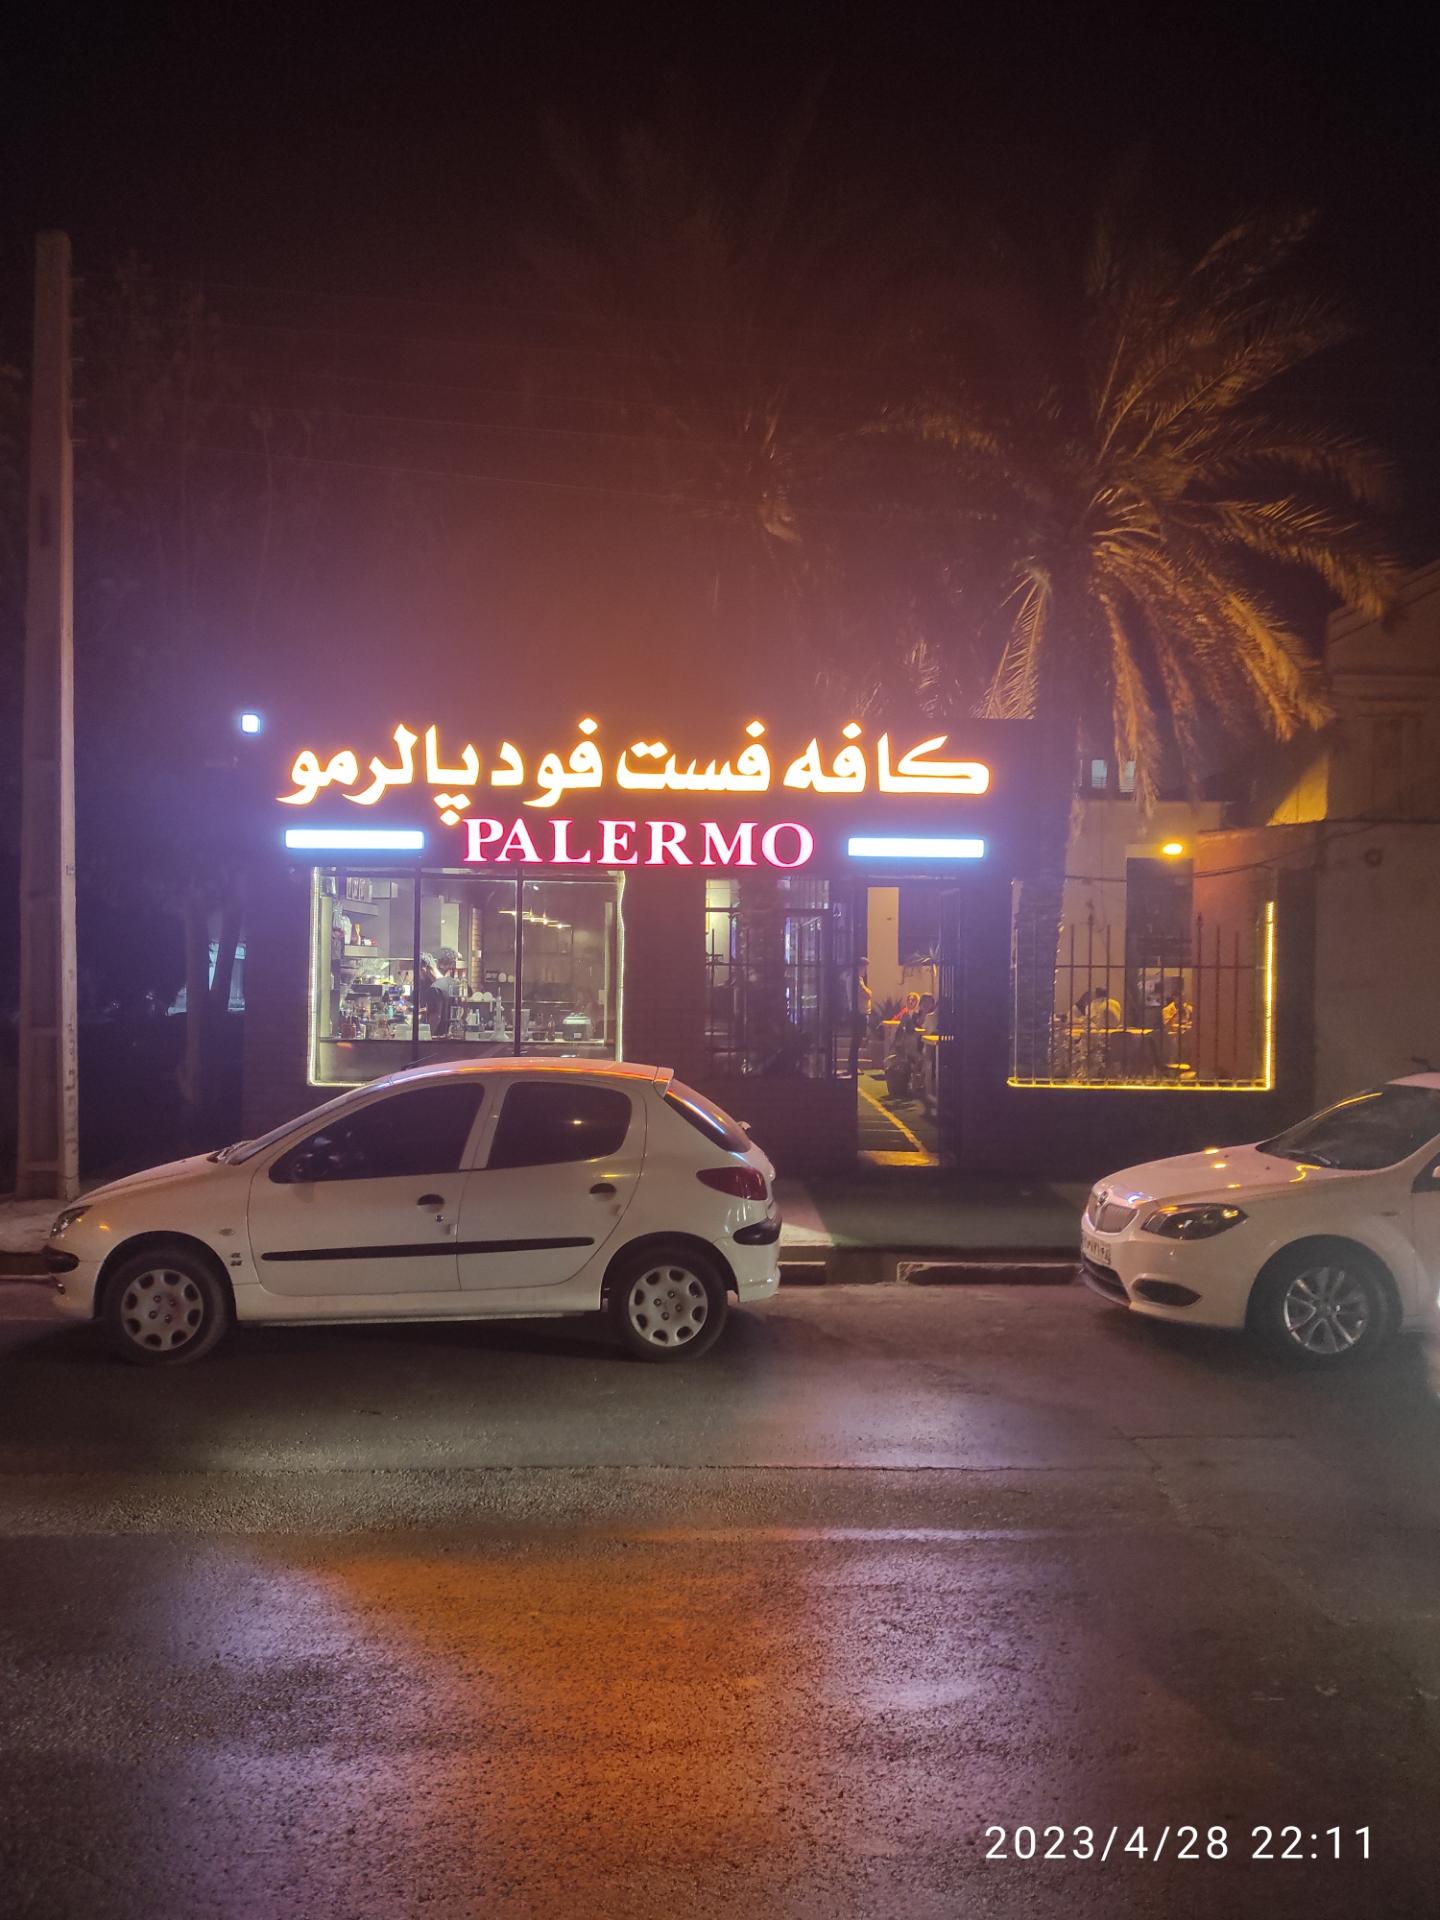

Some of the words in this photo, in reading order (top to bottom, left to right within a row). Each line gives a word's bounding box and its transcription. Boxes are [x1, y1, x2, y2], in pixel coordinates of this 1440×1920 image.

[275, 722, 481, 827] پالرمو
[490, 716, 604, 809] فود
[615, 719, 772, 795] فست
[782, 721, 991, 797] کافه
[461, 816, 815, 868] PALERMO
